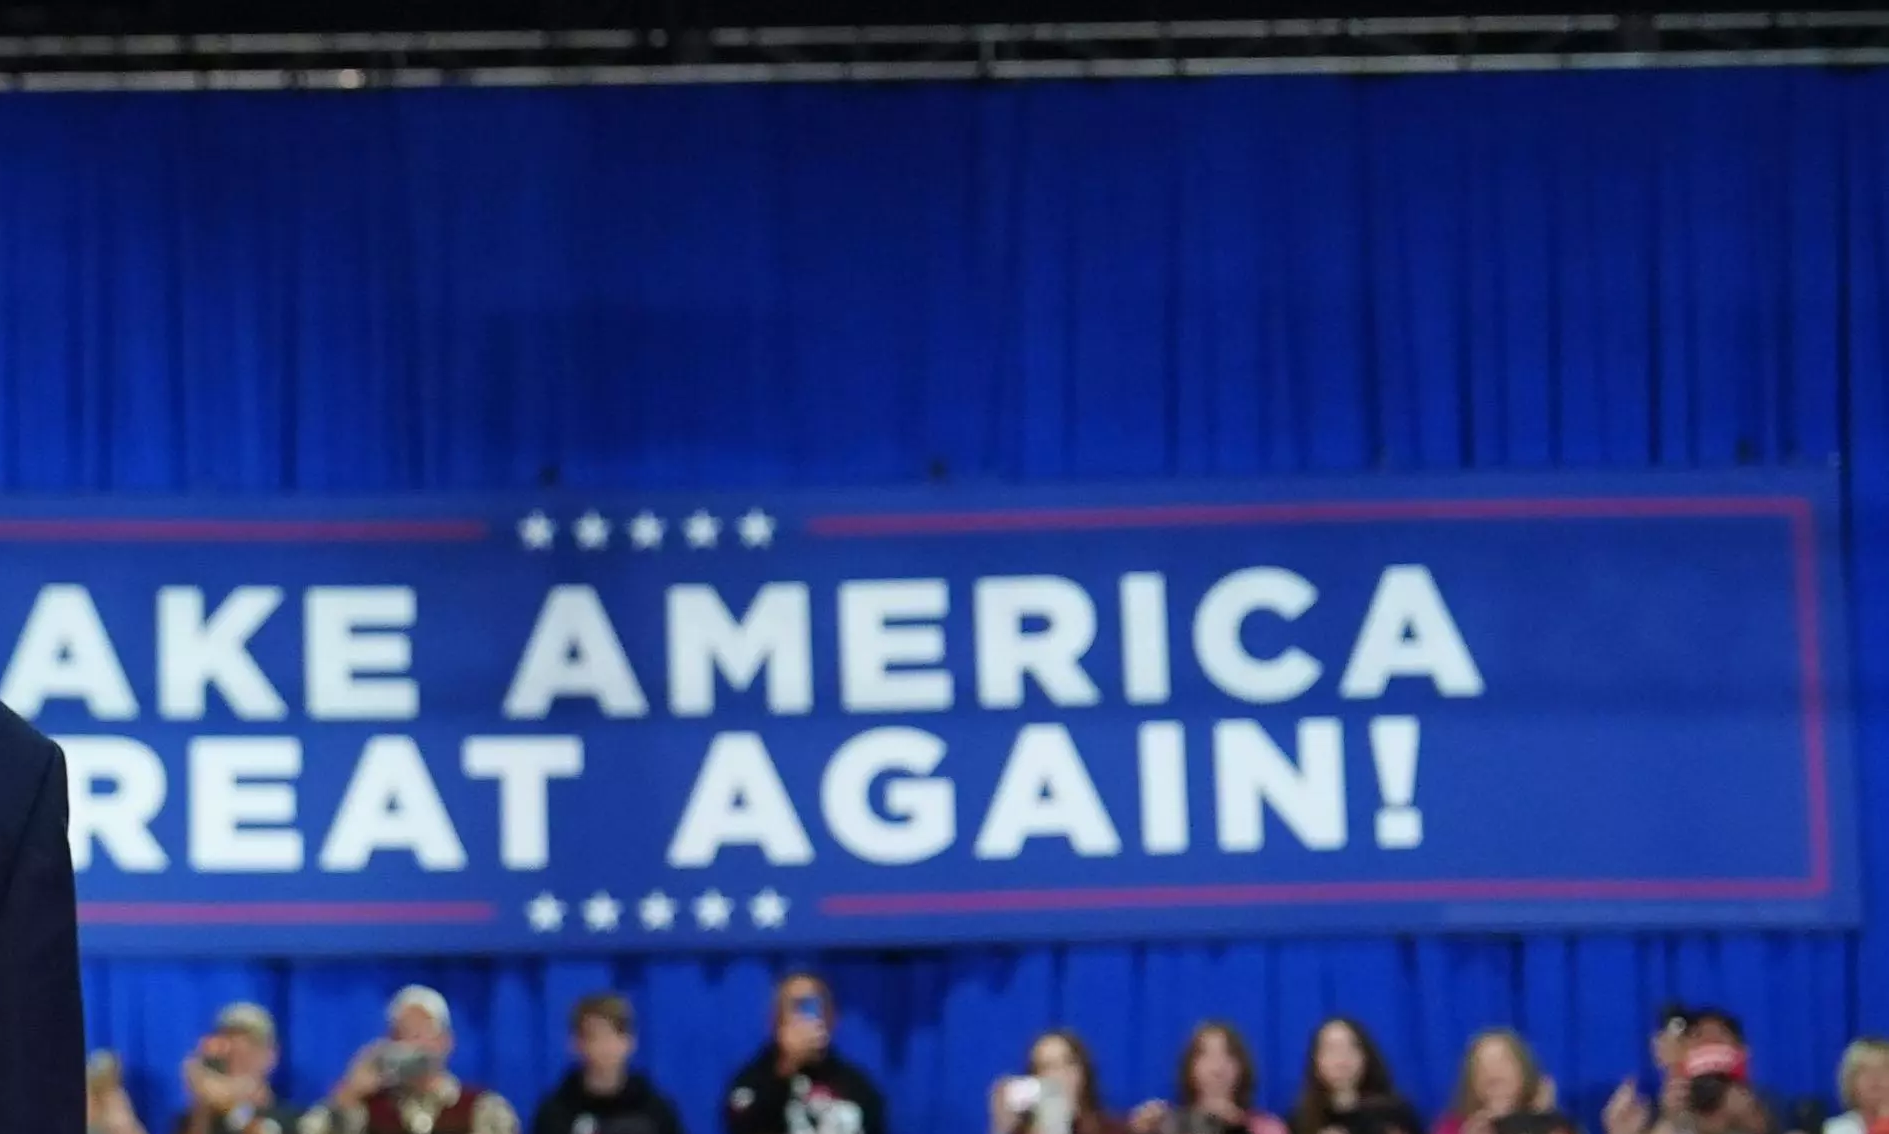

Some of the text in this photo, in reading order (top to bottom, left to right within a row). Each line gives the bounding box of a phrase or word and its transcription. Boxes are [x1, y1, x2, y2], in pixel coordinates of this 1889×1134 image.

[504, 565, 1484, 719] AMERICA
[48, 714, 1423, 874] REAT AGAIN!
